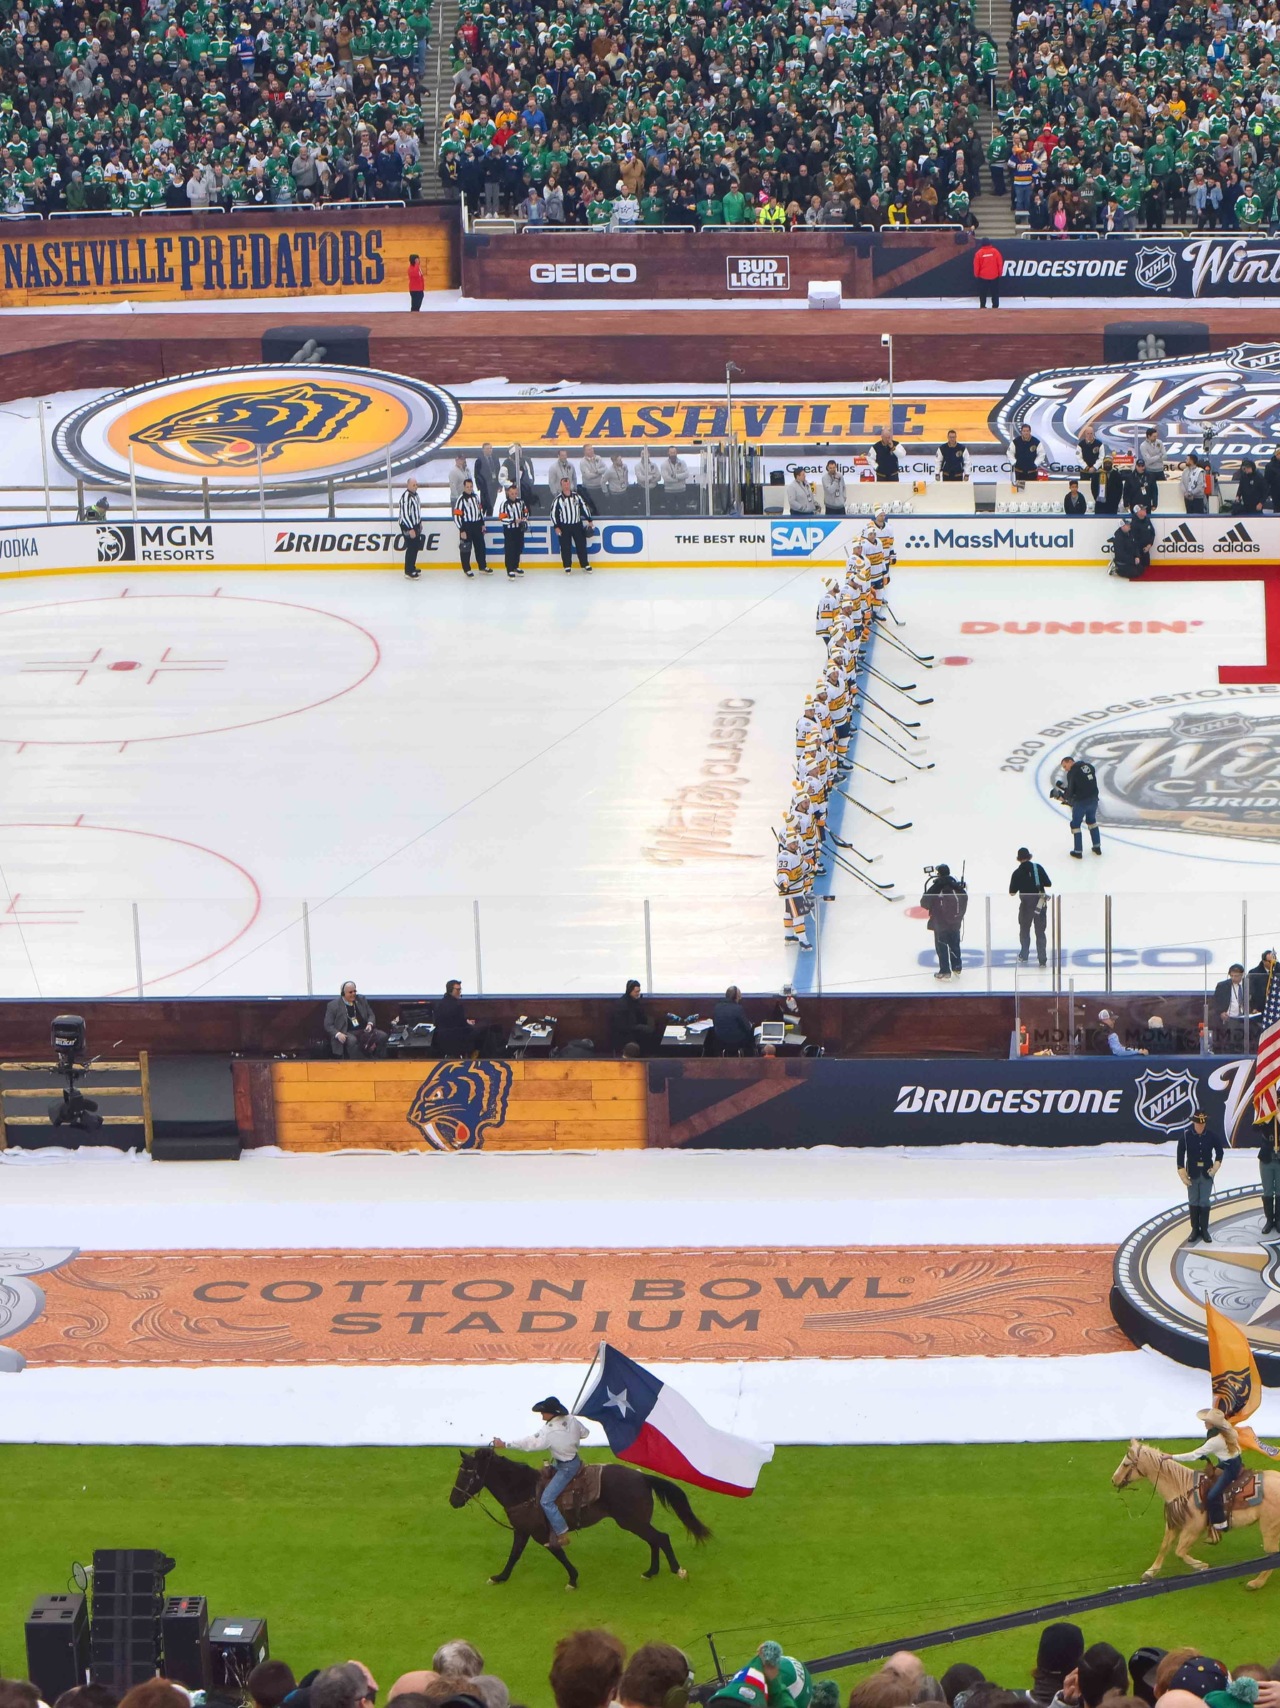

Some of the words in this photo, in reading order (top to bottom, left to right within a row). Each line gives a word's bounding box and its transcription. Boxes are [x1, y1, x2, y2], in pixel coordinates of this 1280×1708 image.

[3, 237, 174, 288] NASHVILLE
[178, 229, 385, 291] PREDATORS
[738, 259, 778, 273] BUD
[1001, 260, 1128, 277] RIDGESTONE
[1141, 257, 1170, 278] NHL
[530, 263, 637, 283] GEICO
[730, 272, 785, 286] LIGHT
[541, 403, 926, 439] NASHVILLE
[912, 462, 935, 475] Clip
[971, 463, 998, 473] reat
[1050, 462, 1081, 474] Grea
[141, 525, 213, 546] MGM
[675, 535, 698, 544] THE
[703, 534, 736, 543] BEST
[743, 534, 765, 543] RUN
[772, 526, 825, 551] SAP
[934, 528, 1074, 548] MassMutual
[142, 549, 215, 561] RESORTS
[1157, 542, 1205, 553] adidas
[1212, 541, 1260, 553] adidas
[960, 621, 1205, 635] DUNKIN'
[1000, 740, 1045, 774] 2020
[1038, 685, 1280, 738] BRIDGESTONE
[1189, 716, 1239, 735] NHL
[917, 948, 1213, 968] GEICO
[893, 1085, 1124, 1114] BRIDGESTONE
[1149, 1083, 1188, 1116] NHL
[192, 1279, 584, 1303] COTTON
[630, 1277, 899, 1301] BOWL
[328, 1308, 761, 1335] STADIUM
